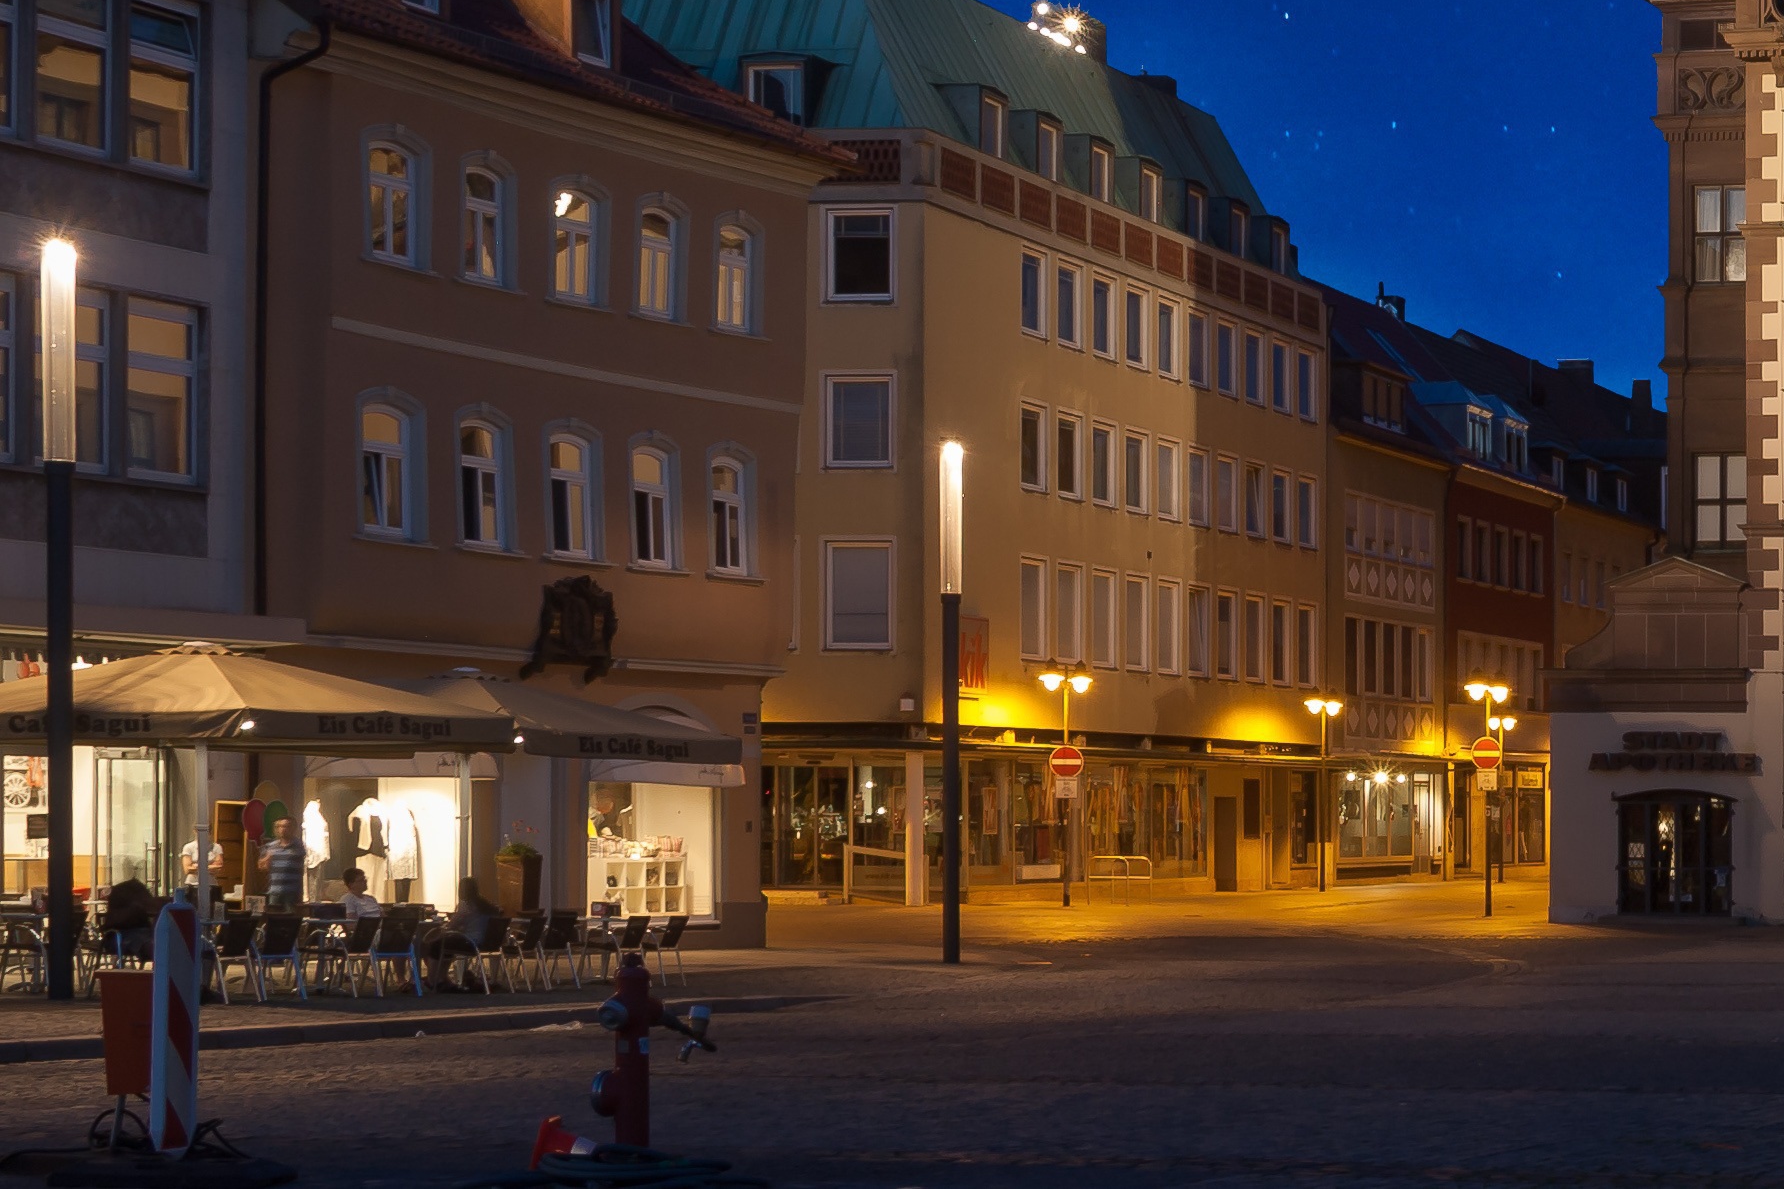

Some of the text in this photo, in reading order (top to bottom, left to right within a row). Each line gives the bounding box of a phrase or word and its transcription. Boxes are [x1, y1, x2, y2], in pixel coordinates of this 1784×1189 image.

[960, 631, 988, 689] kik
[8, 713, 151, 737] Caf Sagui
[317, 715, 452, 739] Eis Café Sagui
[578, 736, 690, 760] Eis Café Sagui
[1622, 731, 1723, 750] STADT
[1588, 752, 1763, 773] APOTHEKE
